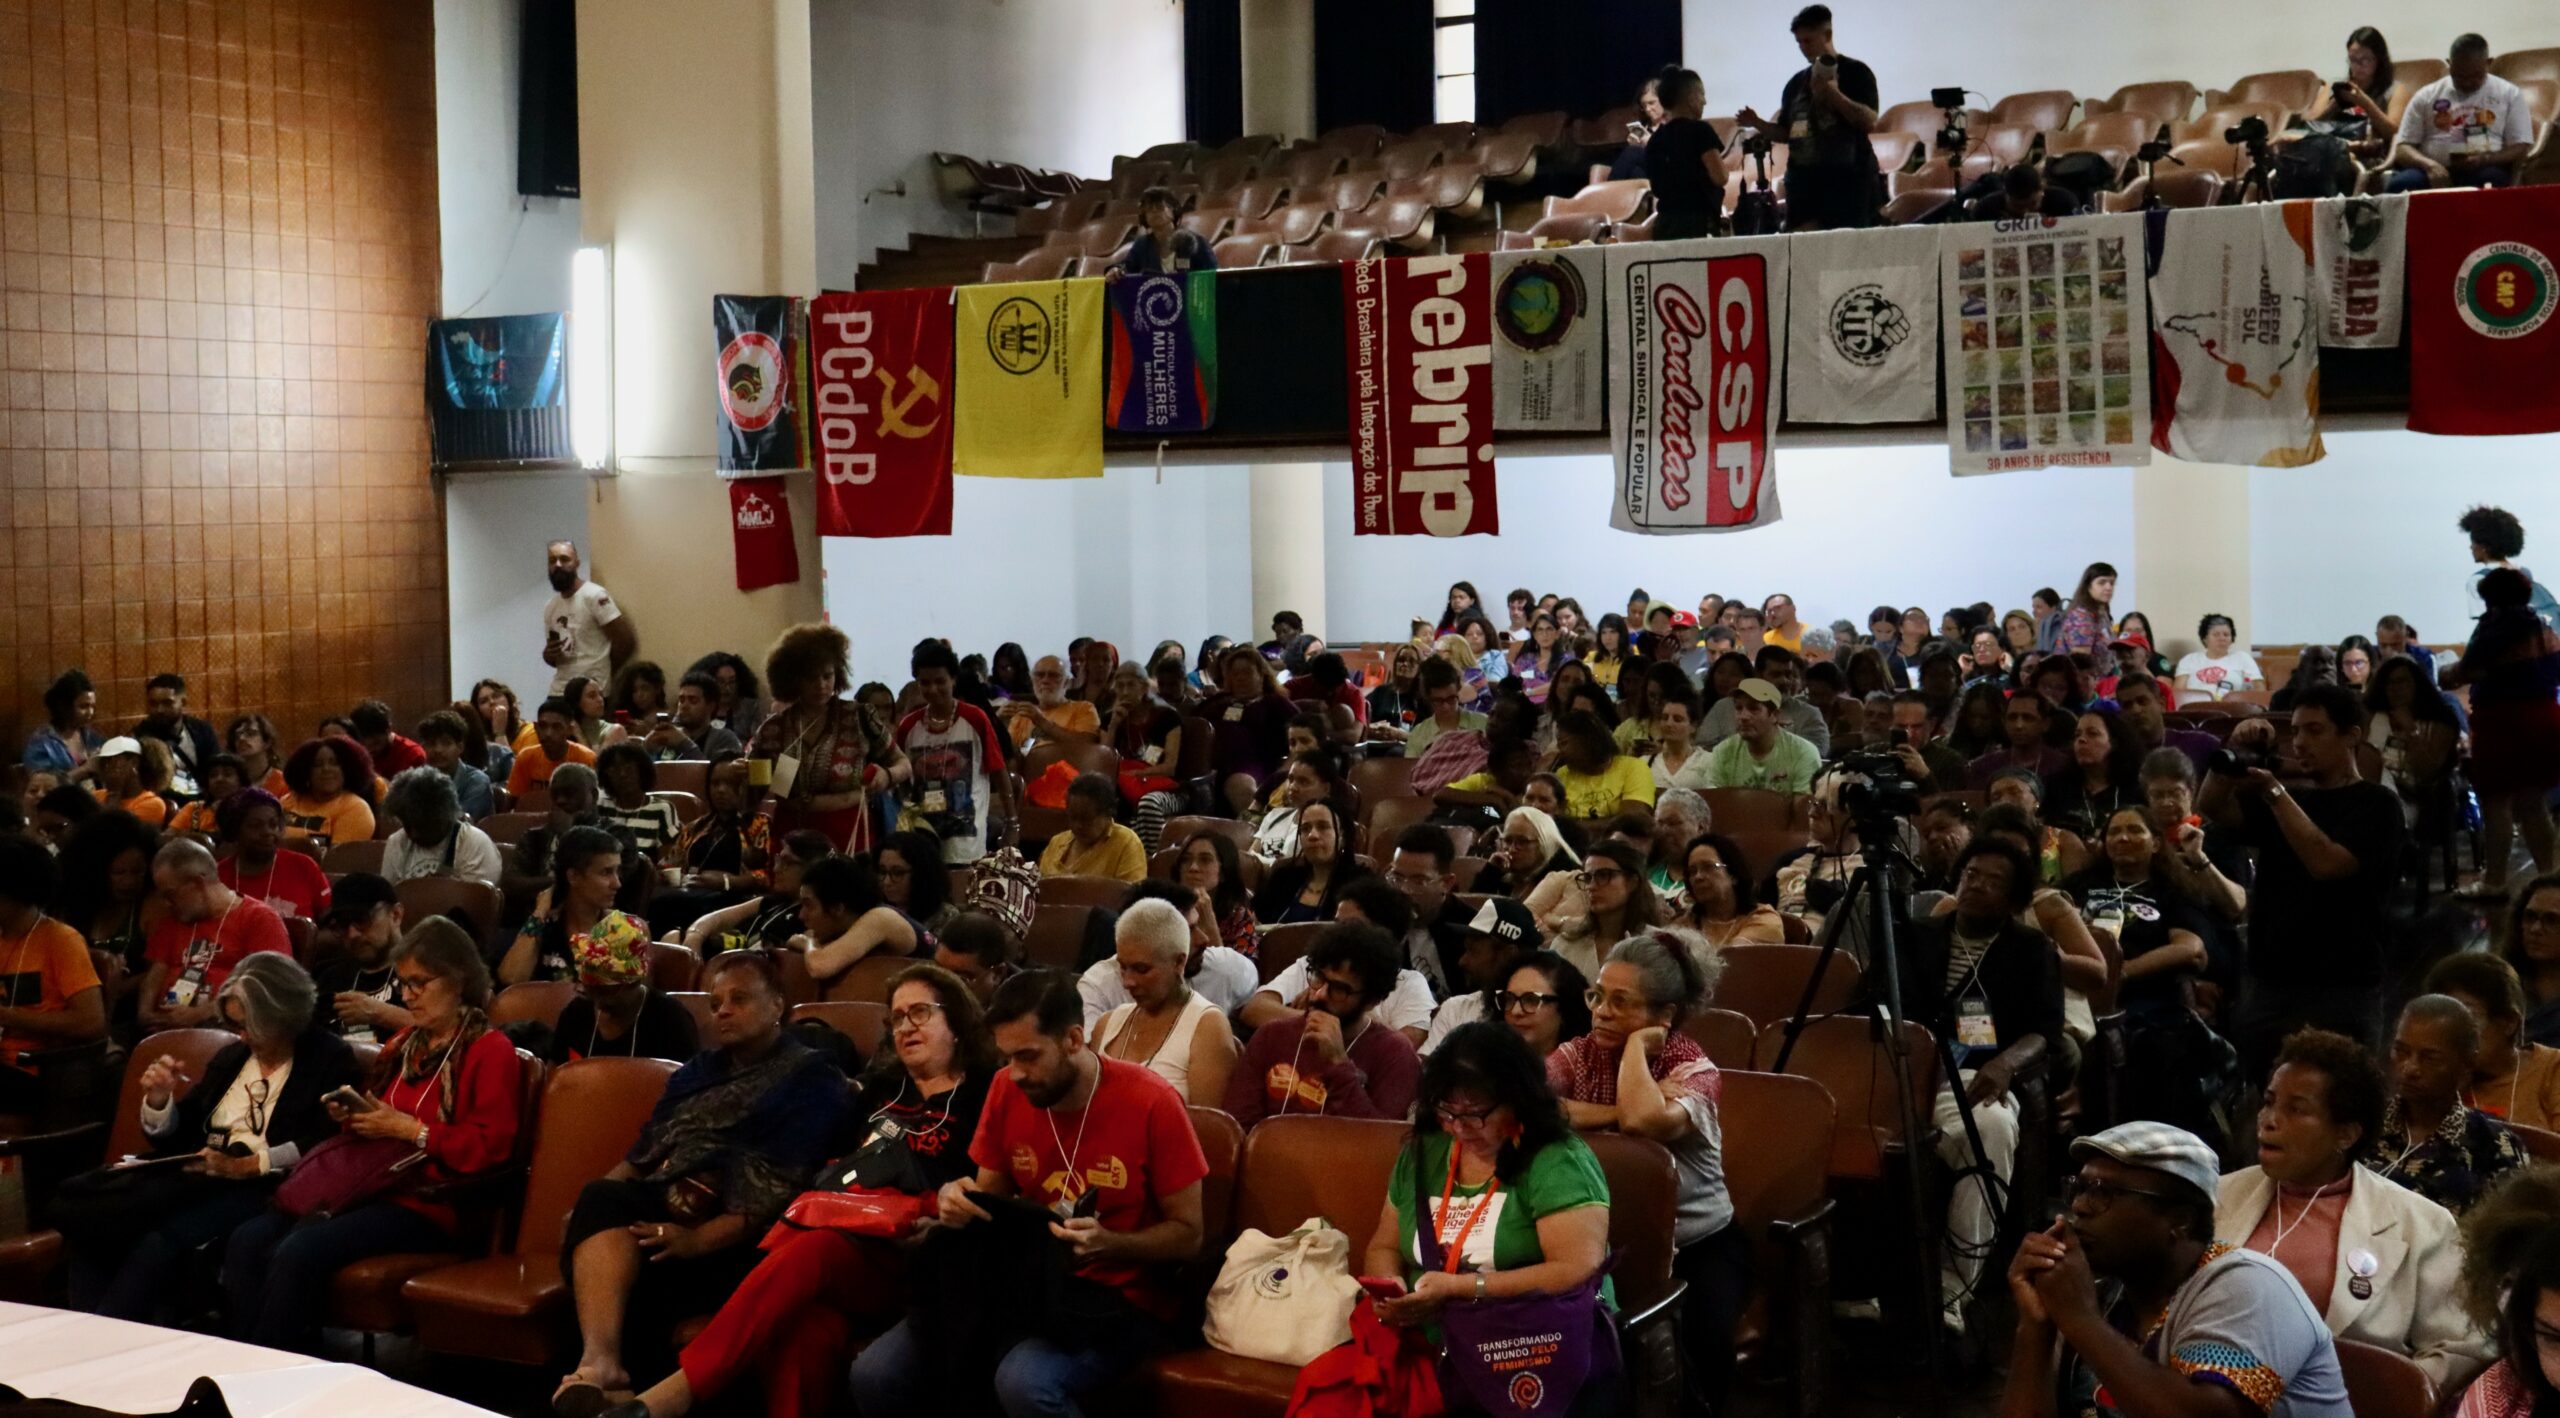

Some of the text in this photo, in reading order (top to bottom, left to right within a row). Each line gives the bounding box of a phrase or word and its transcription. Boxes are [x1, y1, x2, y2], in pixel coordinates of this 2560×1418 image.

[2489, 244, 2528, 255] CENTRAL
[2497, 270, 2515, 308] CMP
[2242, 307, 2257, 344] SUL
[2345, 258, 2381, 337] ALBA
[817, 310, 876, 486] PCdoB
[1144, 361, 1154, 426] BRASILEIRAS
[1152, 331, 1168, 426] MULHERES
[1166, 331, 1178, 418] ARTICULAÇÃO DE
[1355, 259, 1382, 528] Rede Brasileira pela Integração dos Povos
[1399, 254, 1494, 537] rebrip
[1631, 274, 1647, 514] CENTRAL SINDICAL E POPULAR
[1654, 283, 1706, 511] Conlutas
[1717, 277, 1753, 509] CSP
[1987, 450, 2112, 471] 30 ANOS DE RESISTÊNCIA
[1477, 1332, 1562, 1353] TRANSFORMANDO
[1484, 1343, 1558, 1362] O MUNDO PELO
[1492, 1355, 1552, 1372] FEMINISMO
